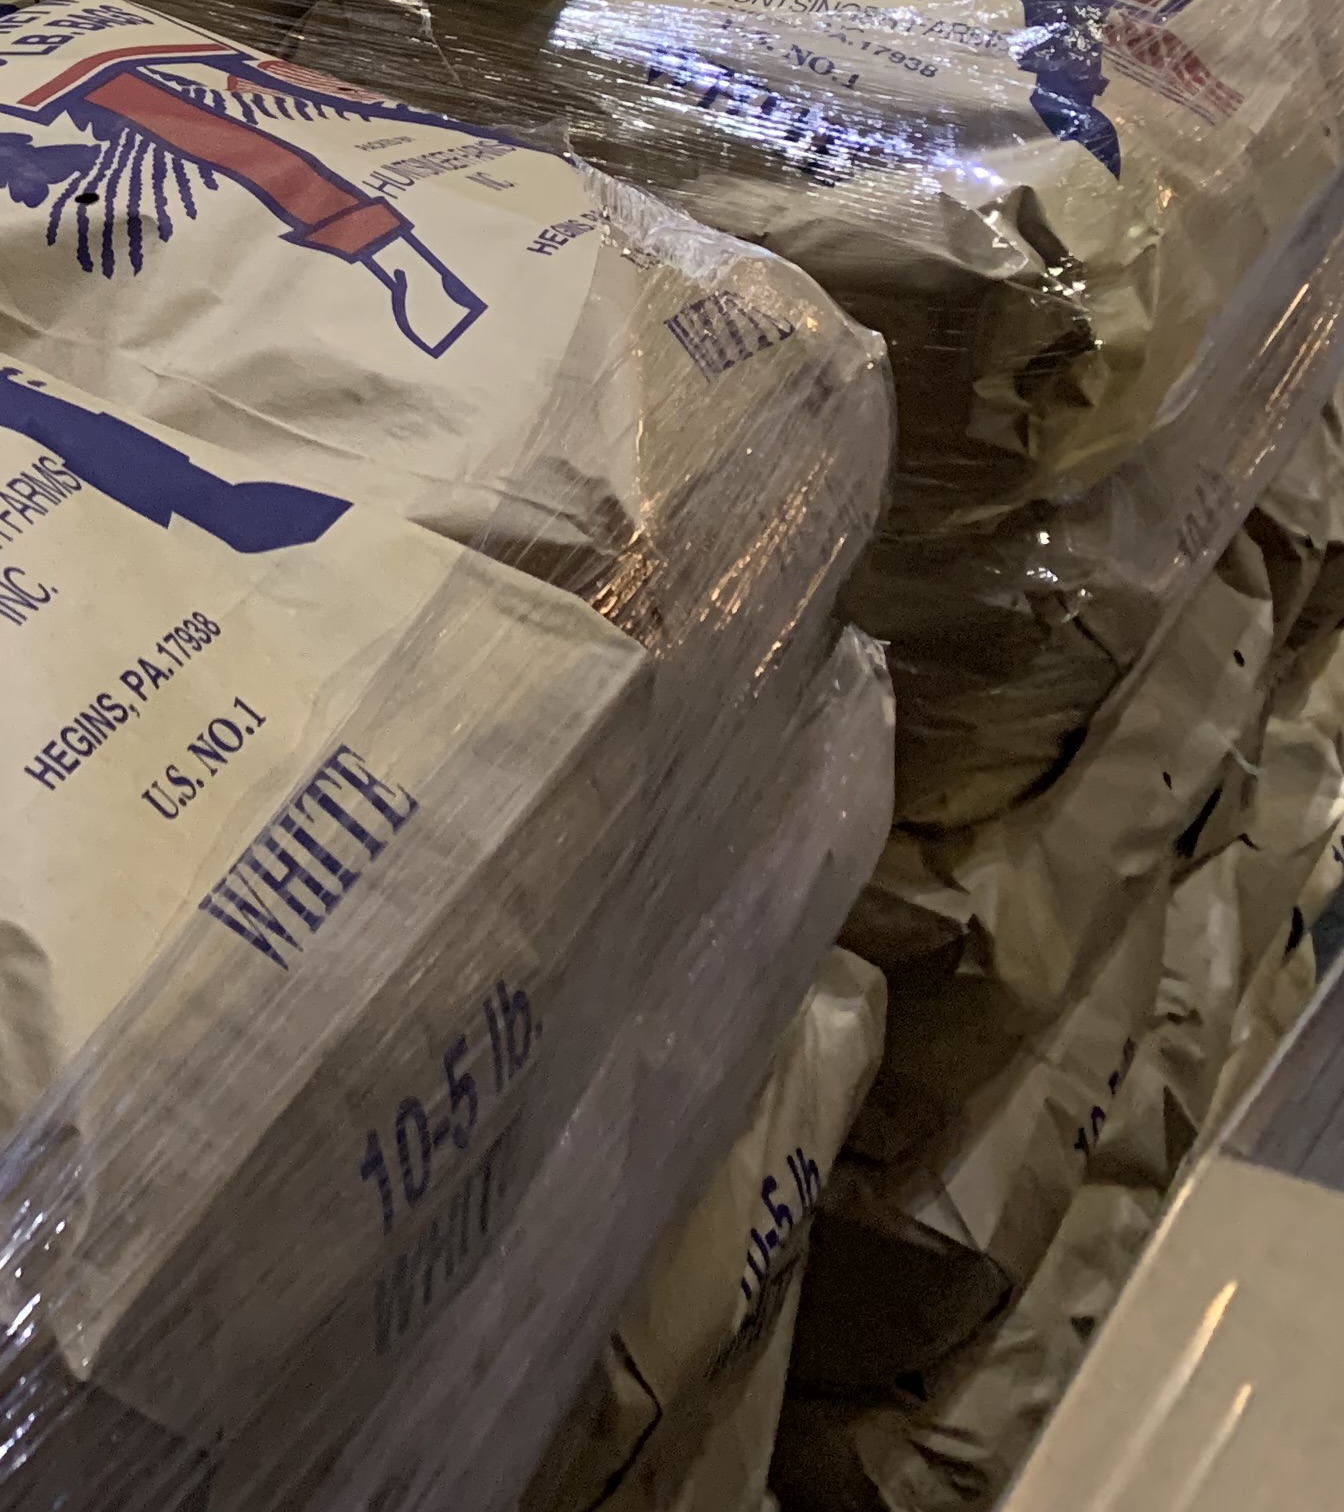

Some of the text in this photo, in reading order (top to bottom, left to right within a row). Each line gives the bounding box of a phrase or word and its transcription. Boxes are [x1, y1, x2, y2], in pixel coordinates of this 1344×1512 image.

[23, 688, 140, 792] HEGINS,
[141, 695, 268, 820] U.S. NO.1
[197, 743, 419, 973] WHITE
[358, 1033, 481, 1237] 10-5
